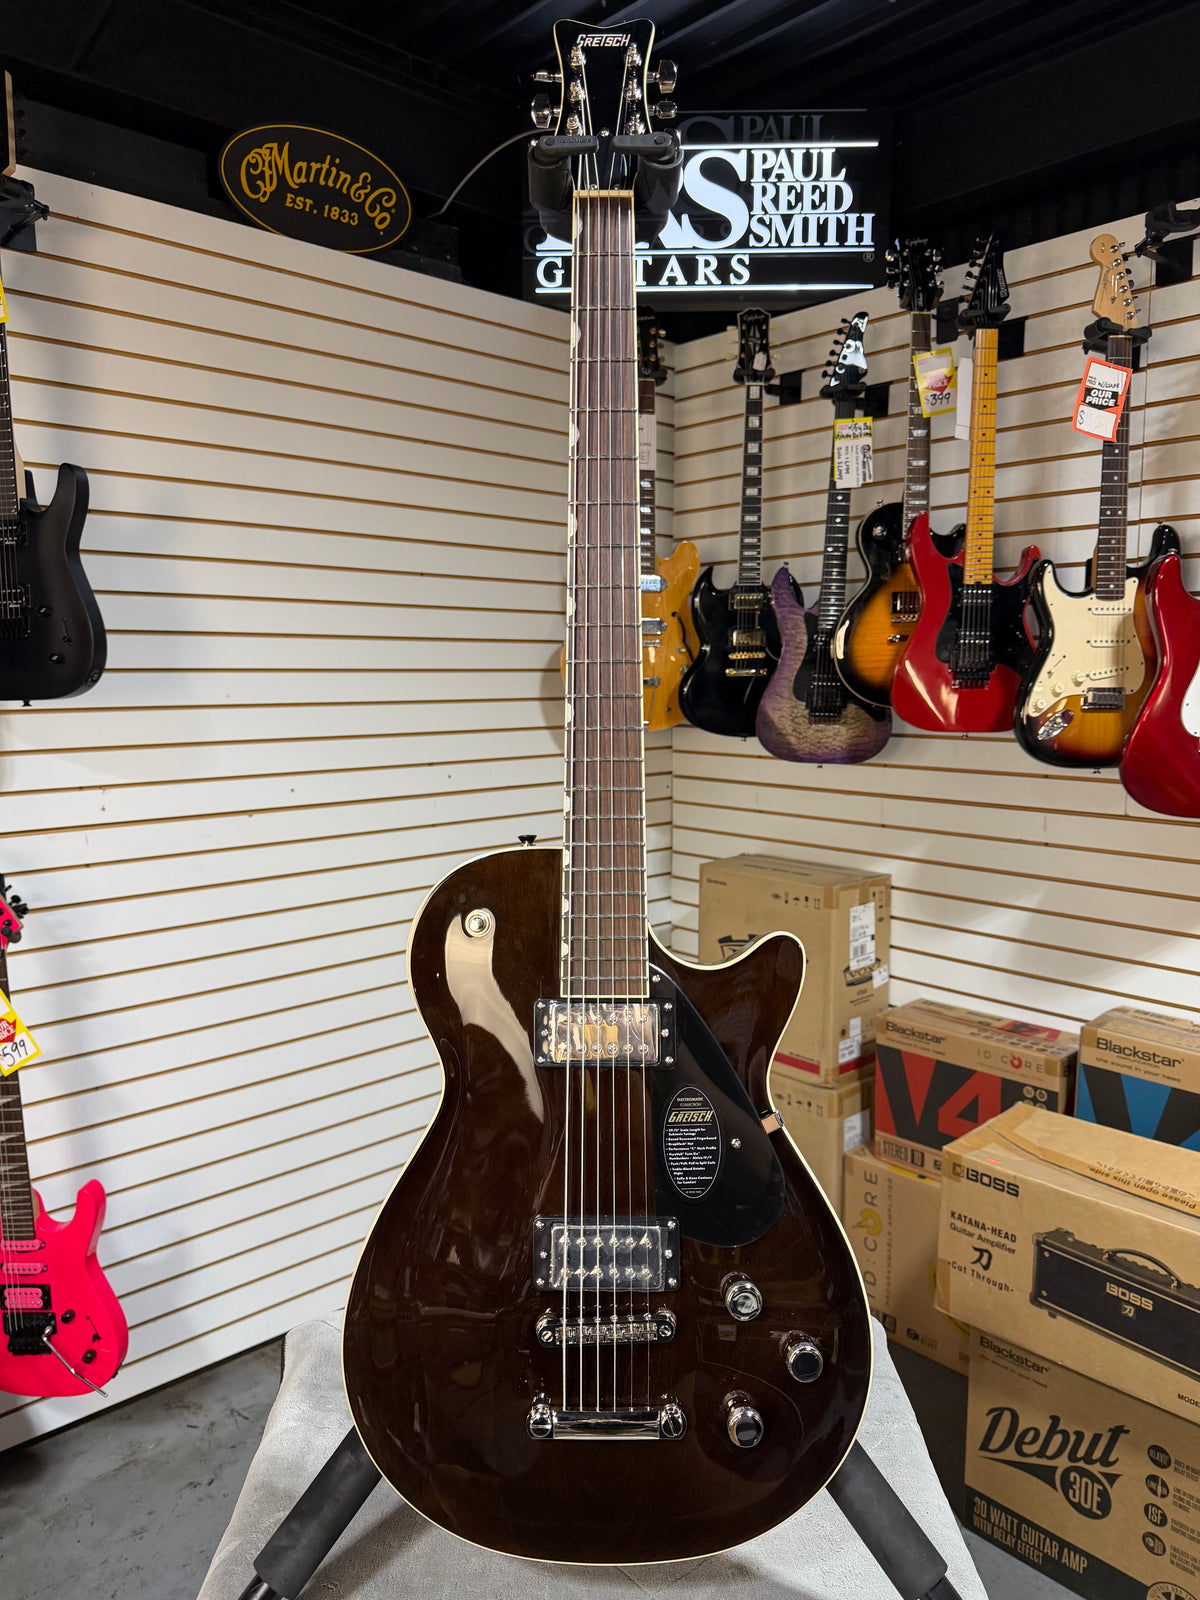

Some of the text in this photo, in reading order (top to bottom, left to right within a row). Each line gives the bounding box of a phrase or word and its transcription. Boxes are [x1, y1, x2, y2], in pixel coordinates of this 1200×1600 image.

[576, 33, 631, 47] GRETSCH
[750, 148, 847, 182] PAUL
[285, 192, 359, 226] EST. 1833
[750, 181, 854, 214] REED
[749, 213, 876, 247] SMITH
[535, 254, 751, 288] GTARS
[1085, 396, 1116, 407] PRICE
[1090, 389, 1112, 399] OUR
[885, 1020, 947, 1045] Blackstar
[1096, 1037, 1183, 1068] Blackstar
[668, 1110, 714, 1123] GRETSCH
[882, 1140, 908, 1162] STEREO
[965, 1167, 1020, 1198] BOSS
[1113, 1175, 1130, 1186] this
[1133, 1182, 1159, 1195] open
[1162, 1192, 1197, 1210] Please
[949, 1222, 1017, 1255] Guitar Amplifier
[950, 1210, 1017, 1243] KATANA-HEAD
[1106, 1281, 1154, 1311] BOSS
[979, 1335, 1049, 1375] Blackstar
[978, 1406, 1131, 1468] Debut
[1068, 1471, 1104, 1517] 30E
[1148, 1505, 1163, 1525] ISF
[973, 1496, 1088, 1574] 30 WATT GUITAR AMP
[973, 1514, 1044, 1565] WITH DELAY EFFECT
